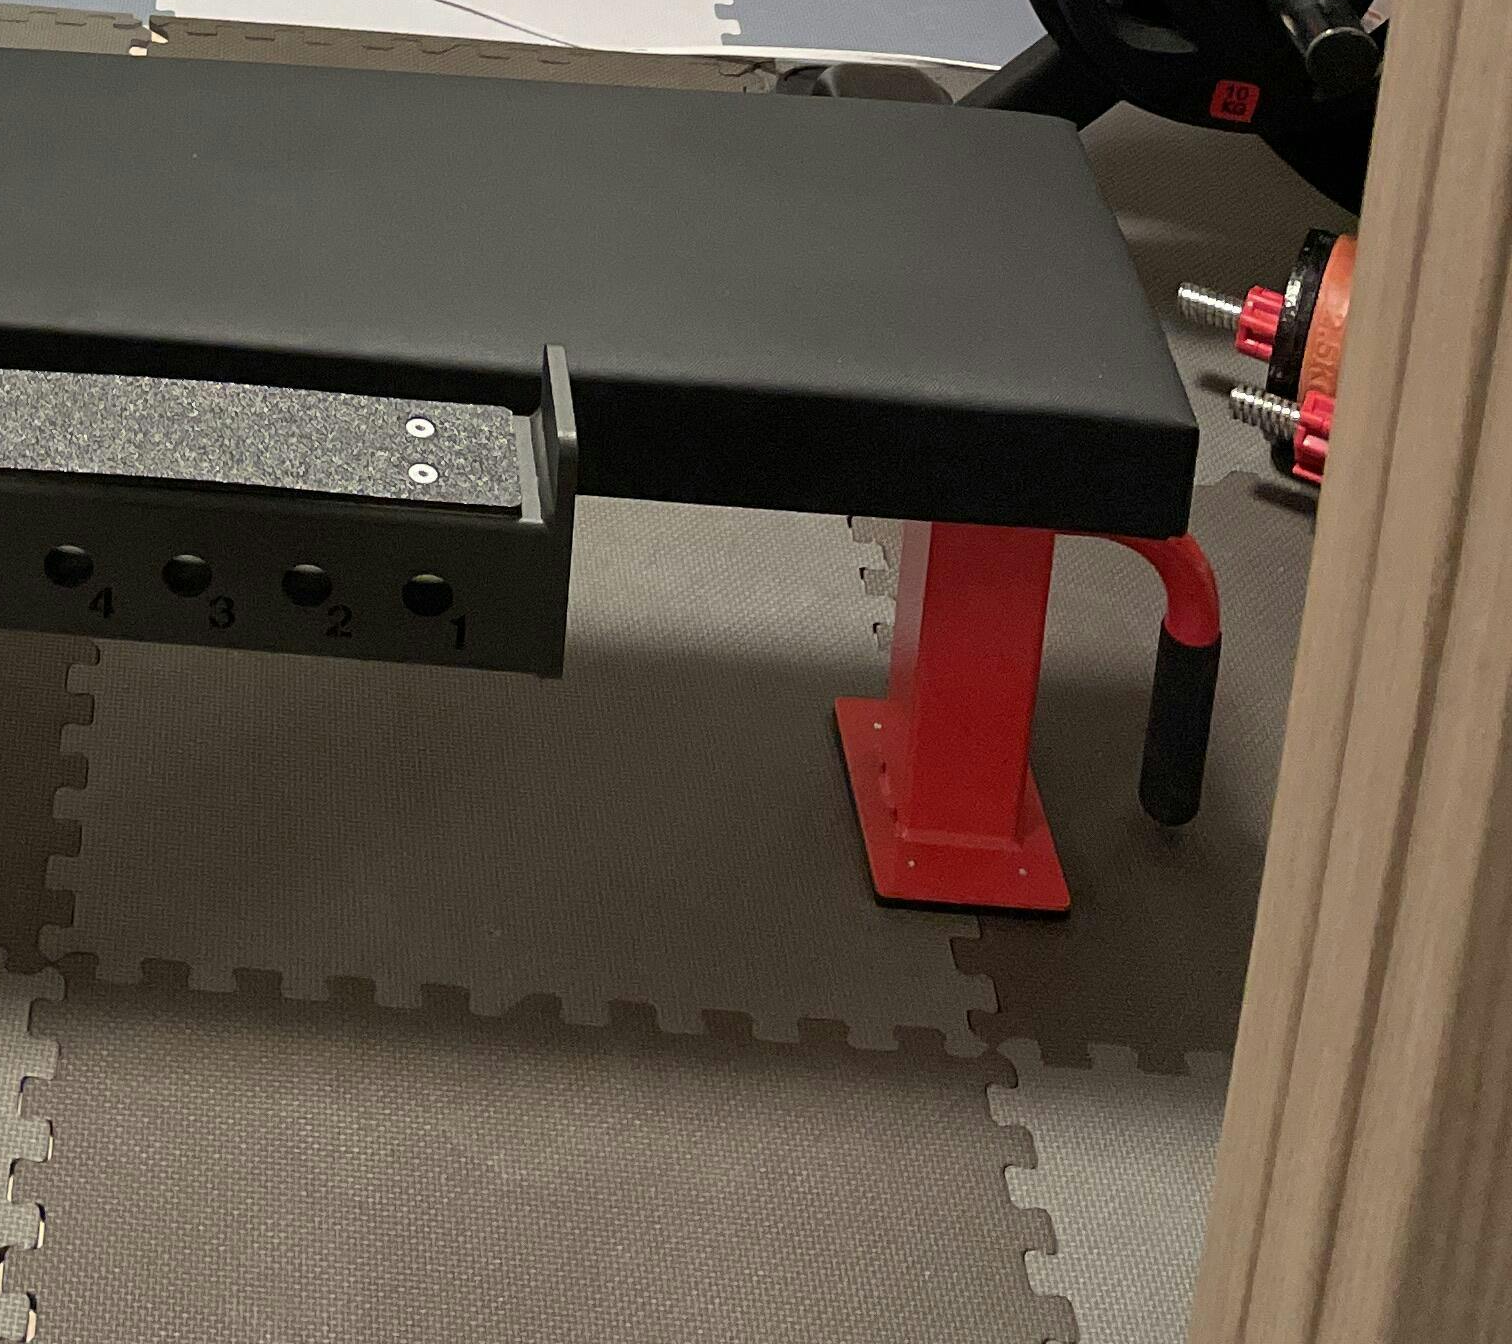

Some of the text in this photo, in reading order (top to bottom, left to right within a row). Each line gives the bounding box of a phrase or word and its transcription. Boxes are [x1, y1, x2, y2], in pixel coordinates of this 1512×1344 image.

[1227, 84, 1250, 101] 10
[1221, 100, 1248, 116] KG
[88, 586, 115, 619] 4
[207, 595, 236, 630] 3
[324, 604, 354, 639] 2
[450, 612, 468, 650] 1
